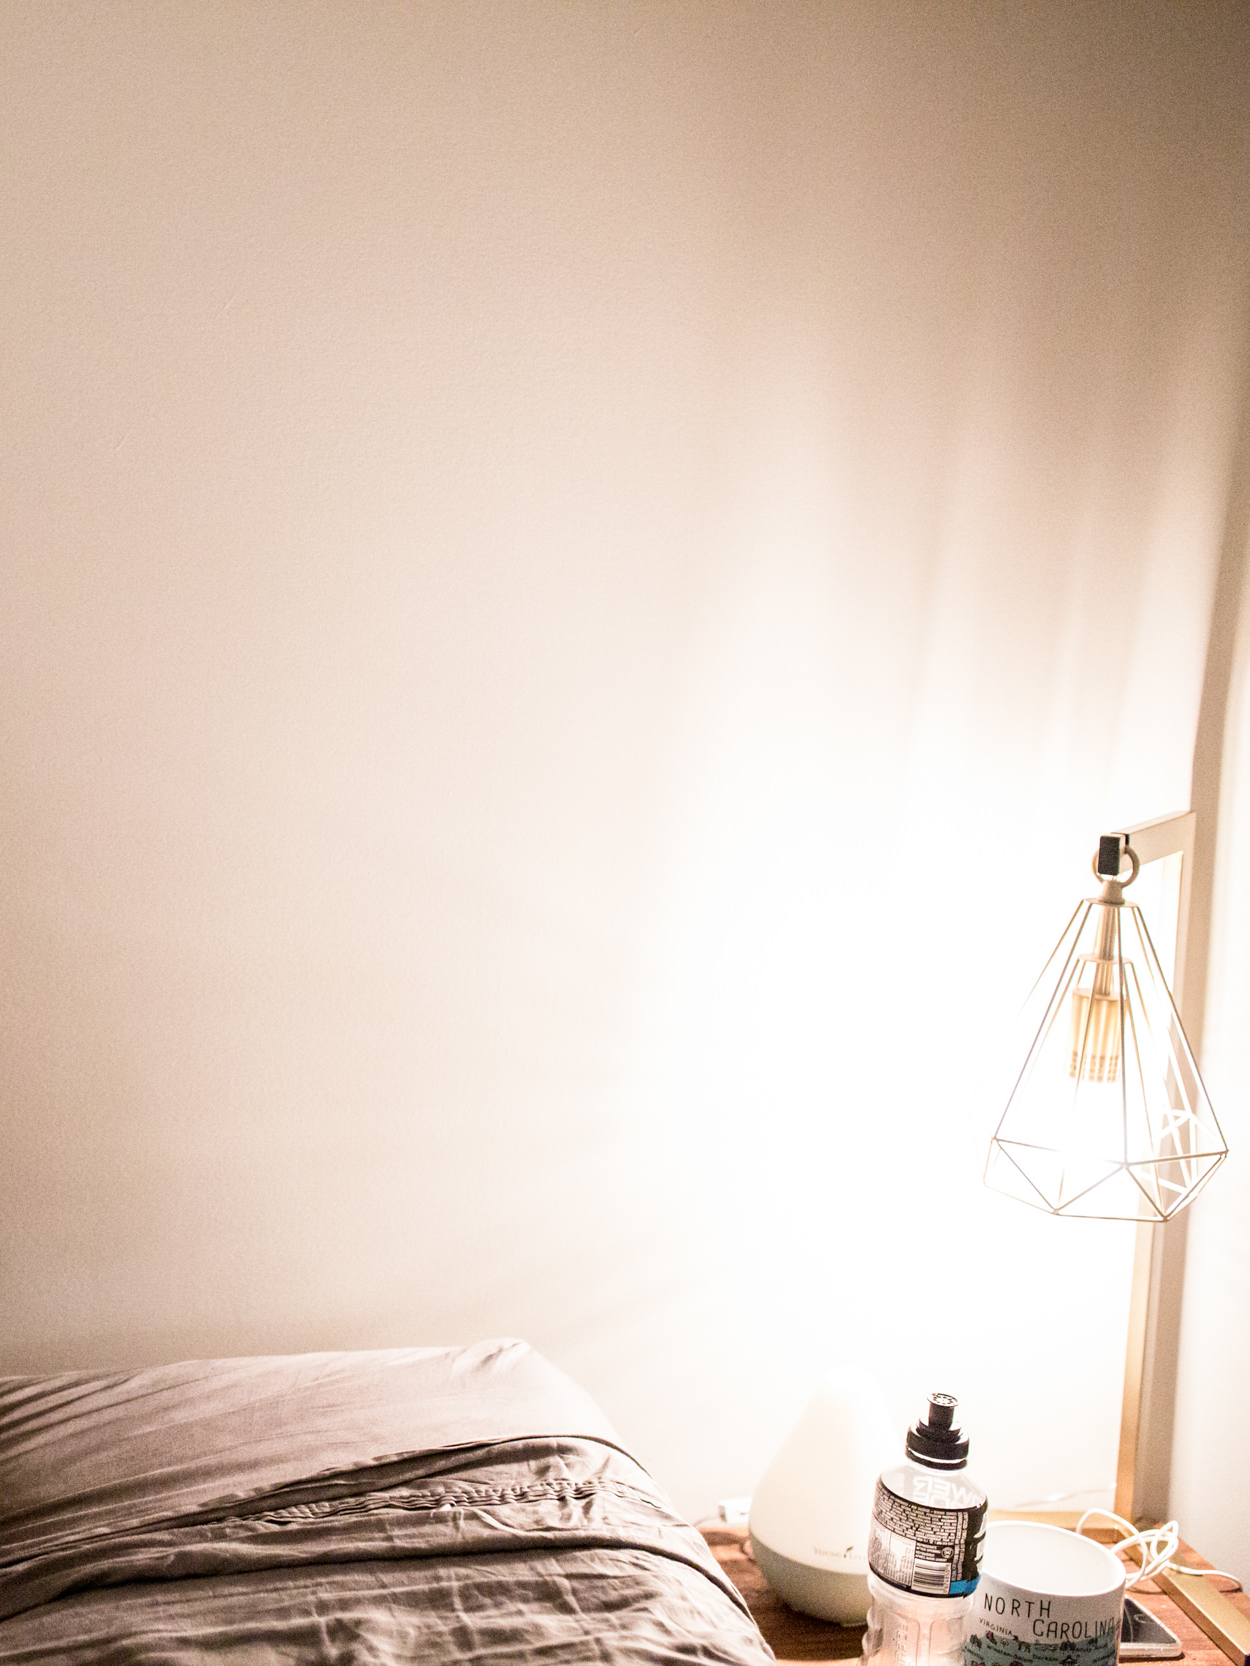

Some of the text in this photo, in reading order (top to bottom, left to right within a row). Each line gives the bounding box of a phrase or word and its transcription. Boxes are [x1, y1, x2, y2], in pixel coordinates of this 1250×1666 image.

[984, 1593, 1051, 1618] NORTH
[979, 1617, 1013, 1636] VIRGINIA
[1032, 1617, 1115, 1640] CAROLINA
